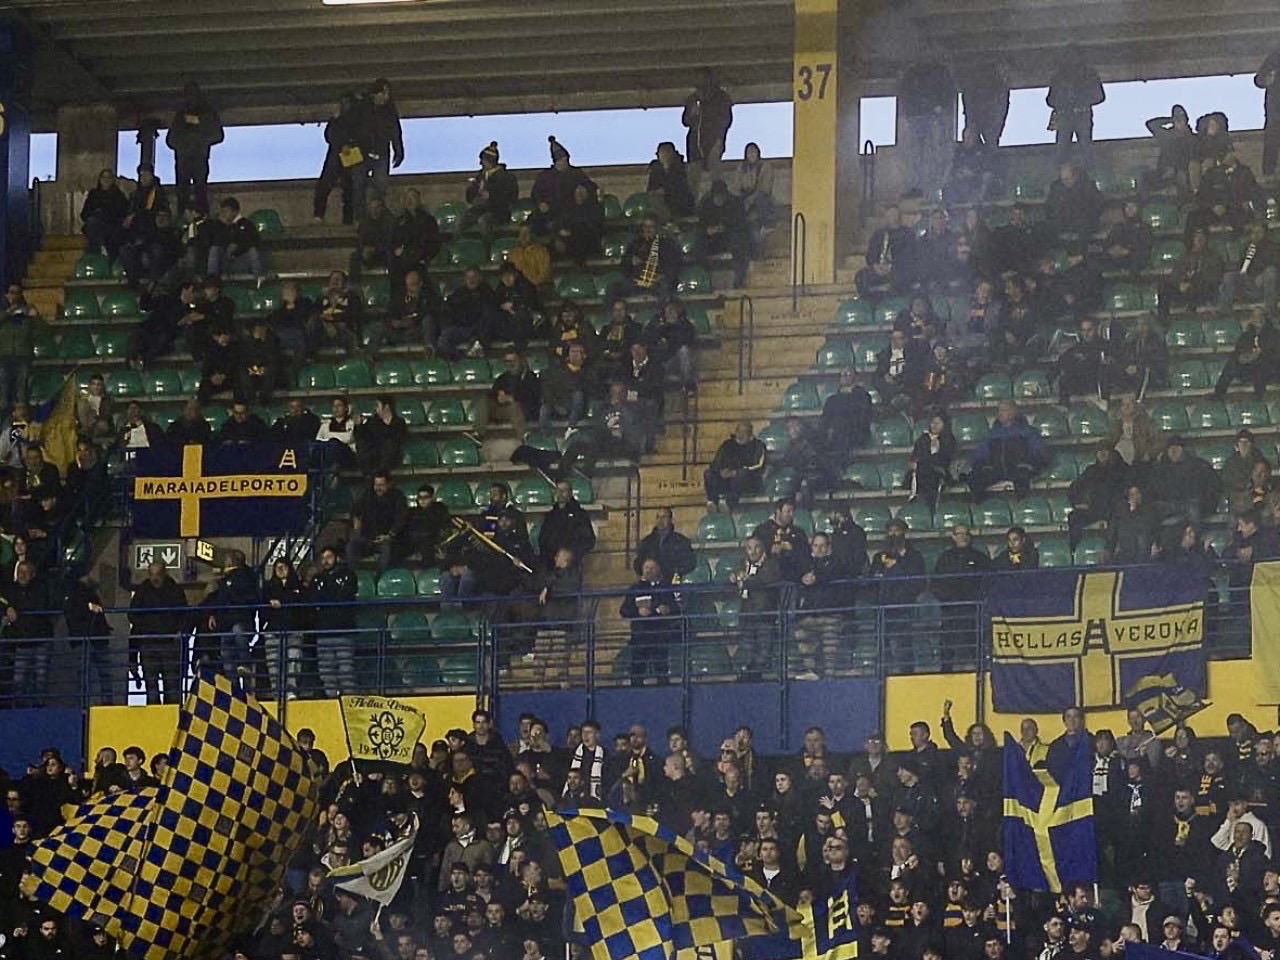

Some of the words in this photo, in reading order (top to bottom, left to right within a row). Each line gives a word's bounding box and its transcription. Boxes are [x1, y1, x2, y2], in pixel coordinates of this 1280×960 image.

[797, 64, 831, 101] 37
[143, 479, 299, 495] MARAIADELPORTO
[996, 631, 1082, 648] HELLAS
[1114, 619, 1198, 642] VERONA
